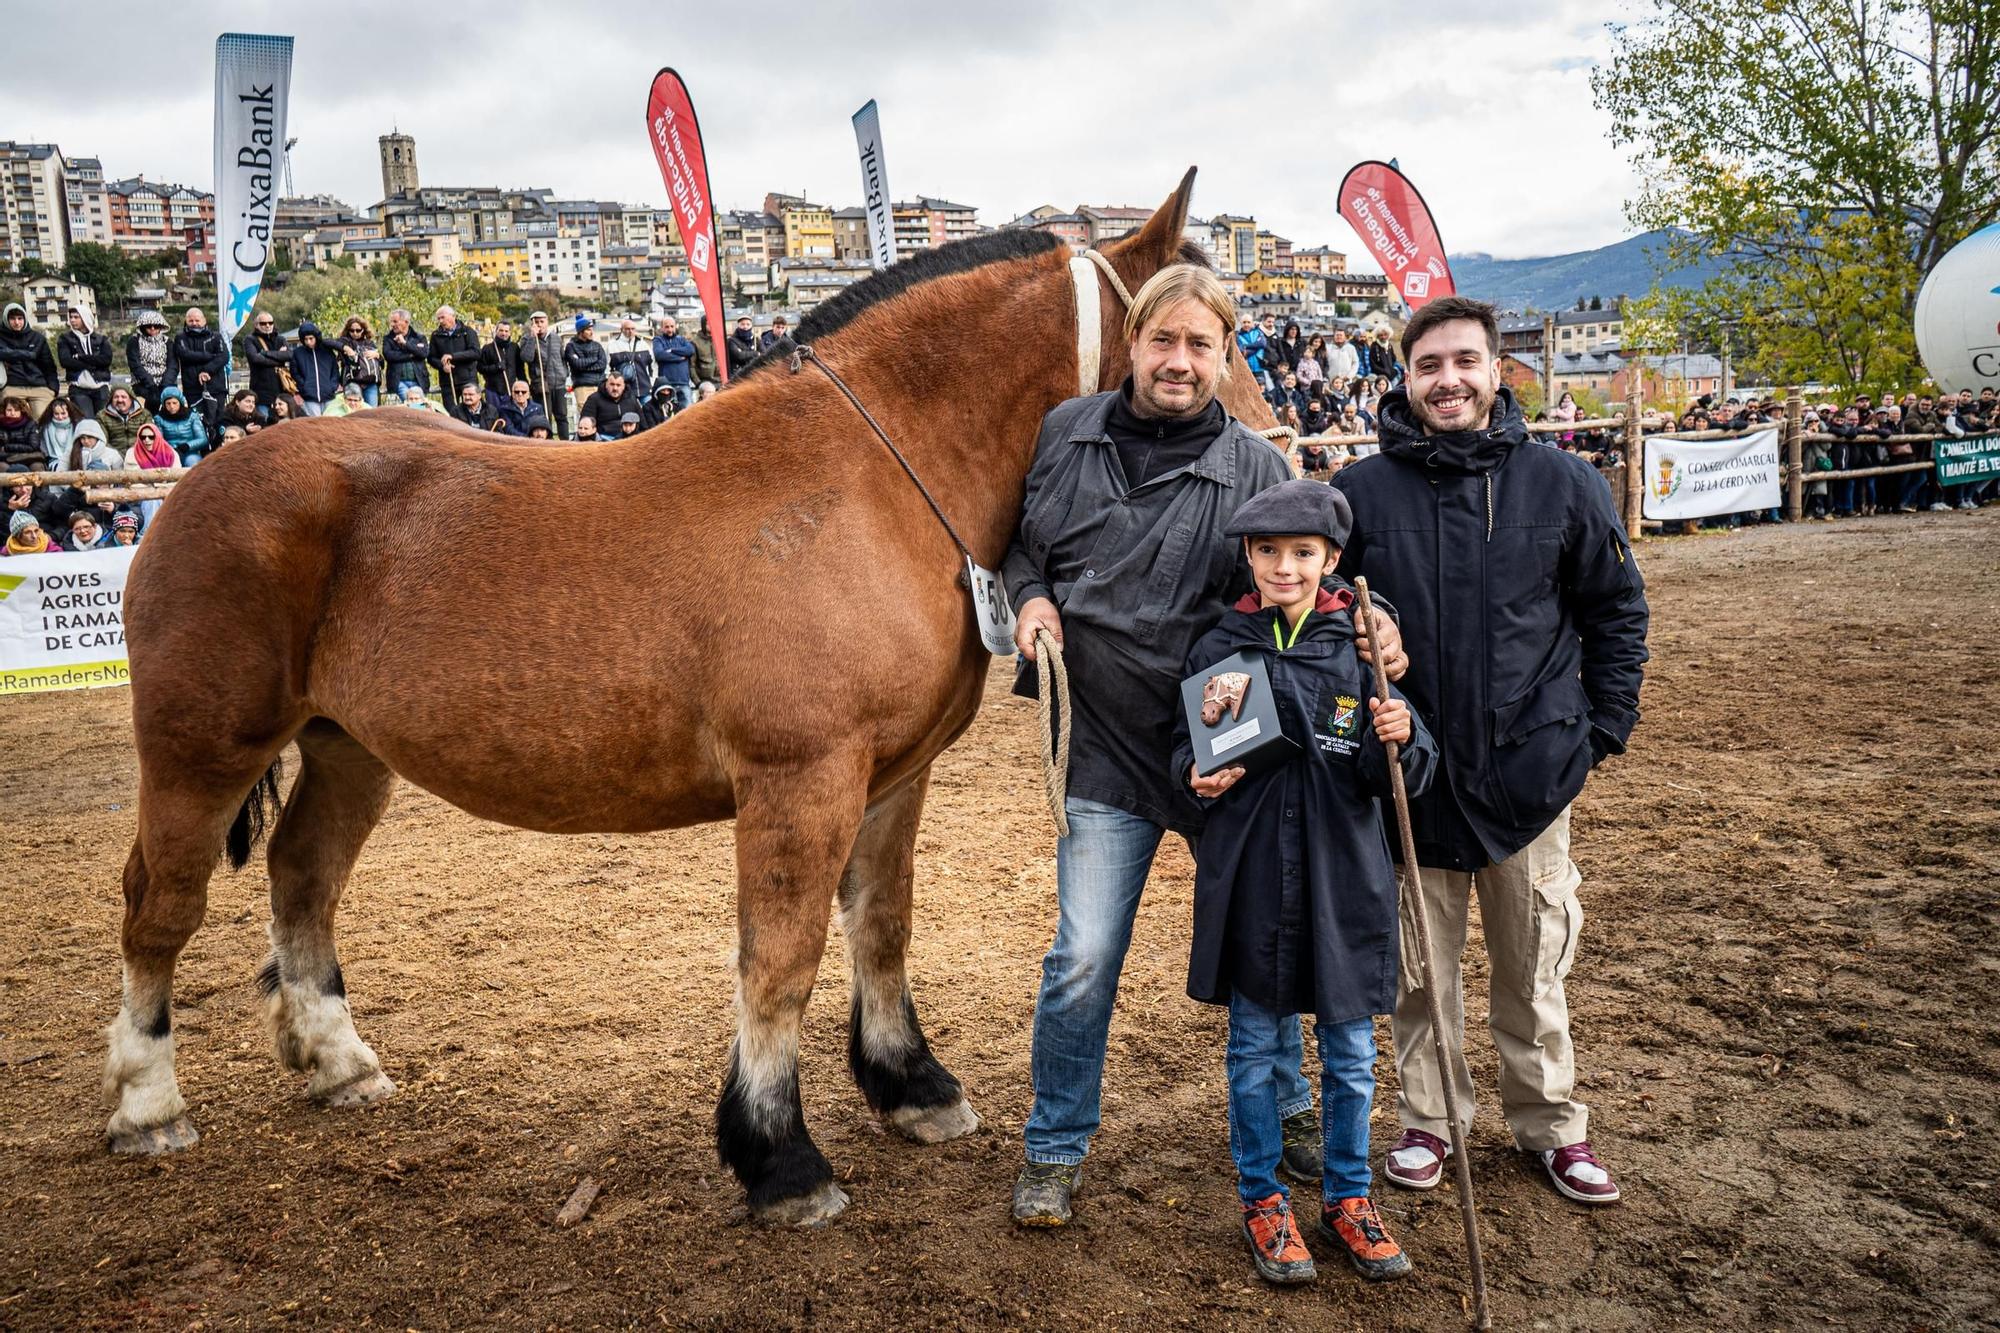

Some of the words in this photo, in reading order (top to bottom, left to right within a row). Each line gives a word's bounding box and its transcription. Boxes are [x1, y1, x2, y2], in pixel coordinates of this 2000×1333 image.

[233, 84, 273, 273] CaixaBank
[1972, 353, 2000, 378] C
[1986, 437, 2000, 451] DO
[1688, 460, 1726, 475] CONSELL
[1725, 453, 1776, 470] COMARCAL
[1946, 456, 1977, 477] MANTÉ
[1978, 458, 1990, 473] EL
[1693, 480, 1705, 492] DE
[1706, 479, 1718, 491] LA
[1720, 472, 1768, 490] CERDANYA
[38, 573, 101, 593] JOVES
[41, 591, 121, 610] AGRICU
[43, 616, 48, 630] I
[55, 611, 124, 629] RAMA
[45, 635, 73, 651] DE
[0, 665, 128, 690] RamadersNo
